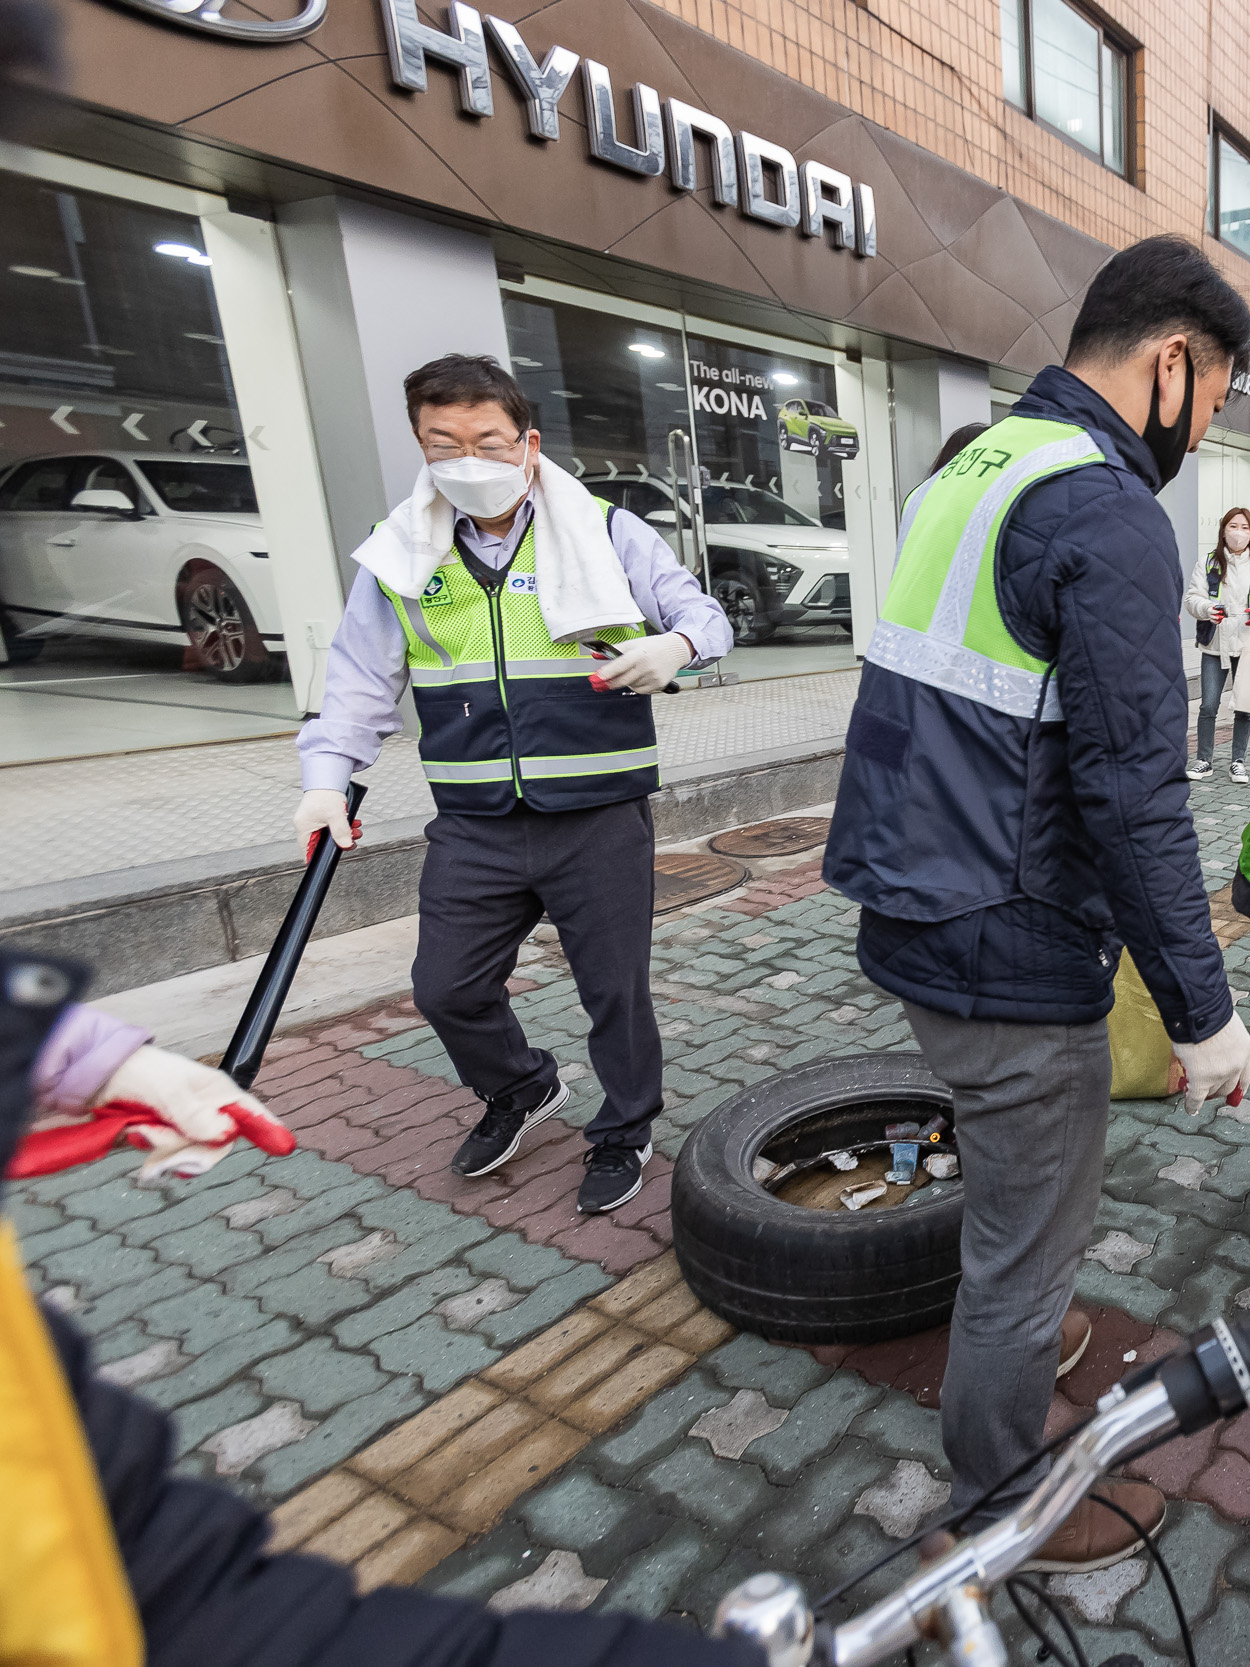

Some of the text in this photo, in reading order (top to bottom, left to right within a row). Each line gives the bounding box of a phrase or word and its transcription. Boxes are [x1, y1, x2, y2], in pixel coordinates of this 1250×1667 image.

[382, 0, 877, 257] HYUNDAI
[690, 360, 775, 390] The all-new
[693, 385, 768, 420] KONA
